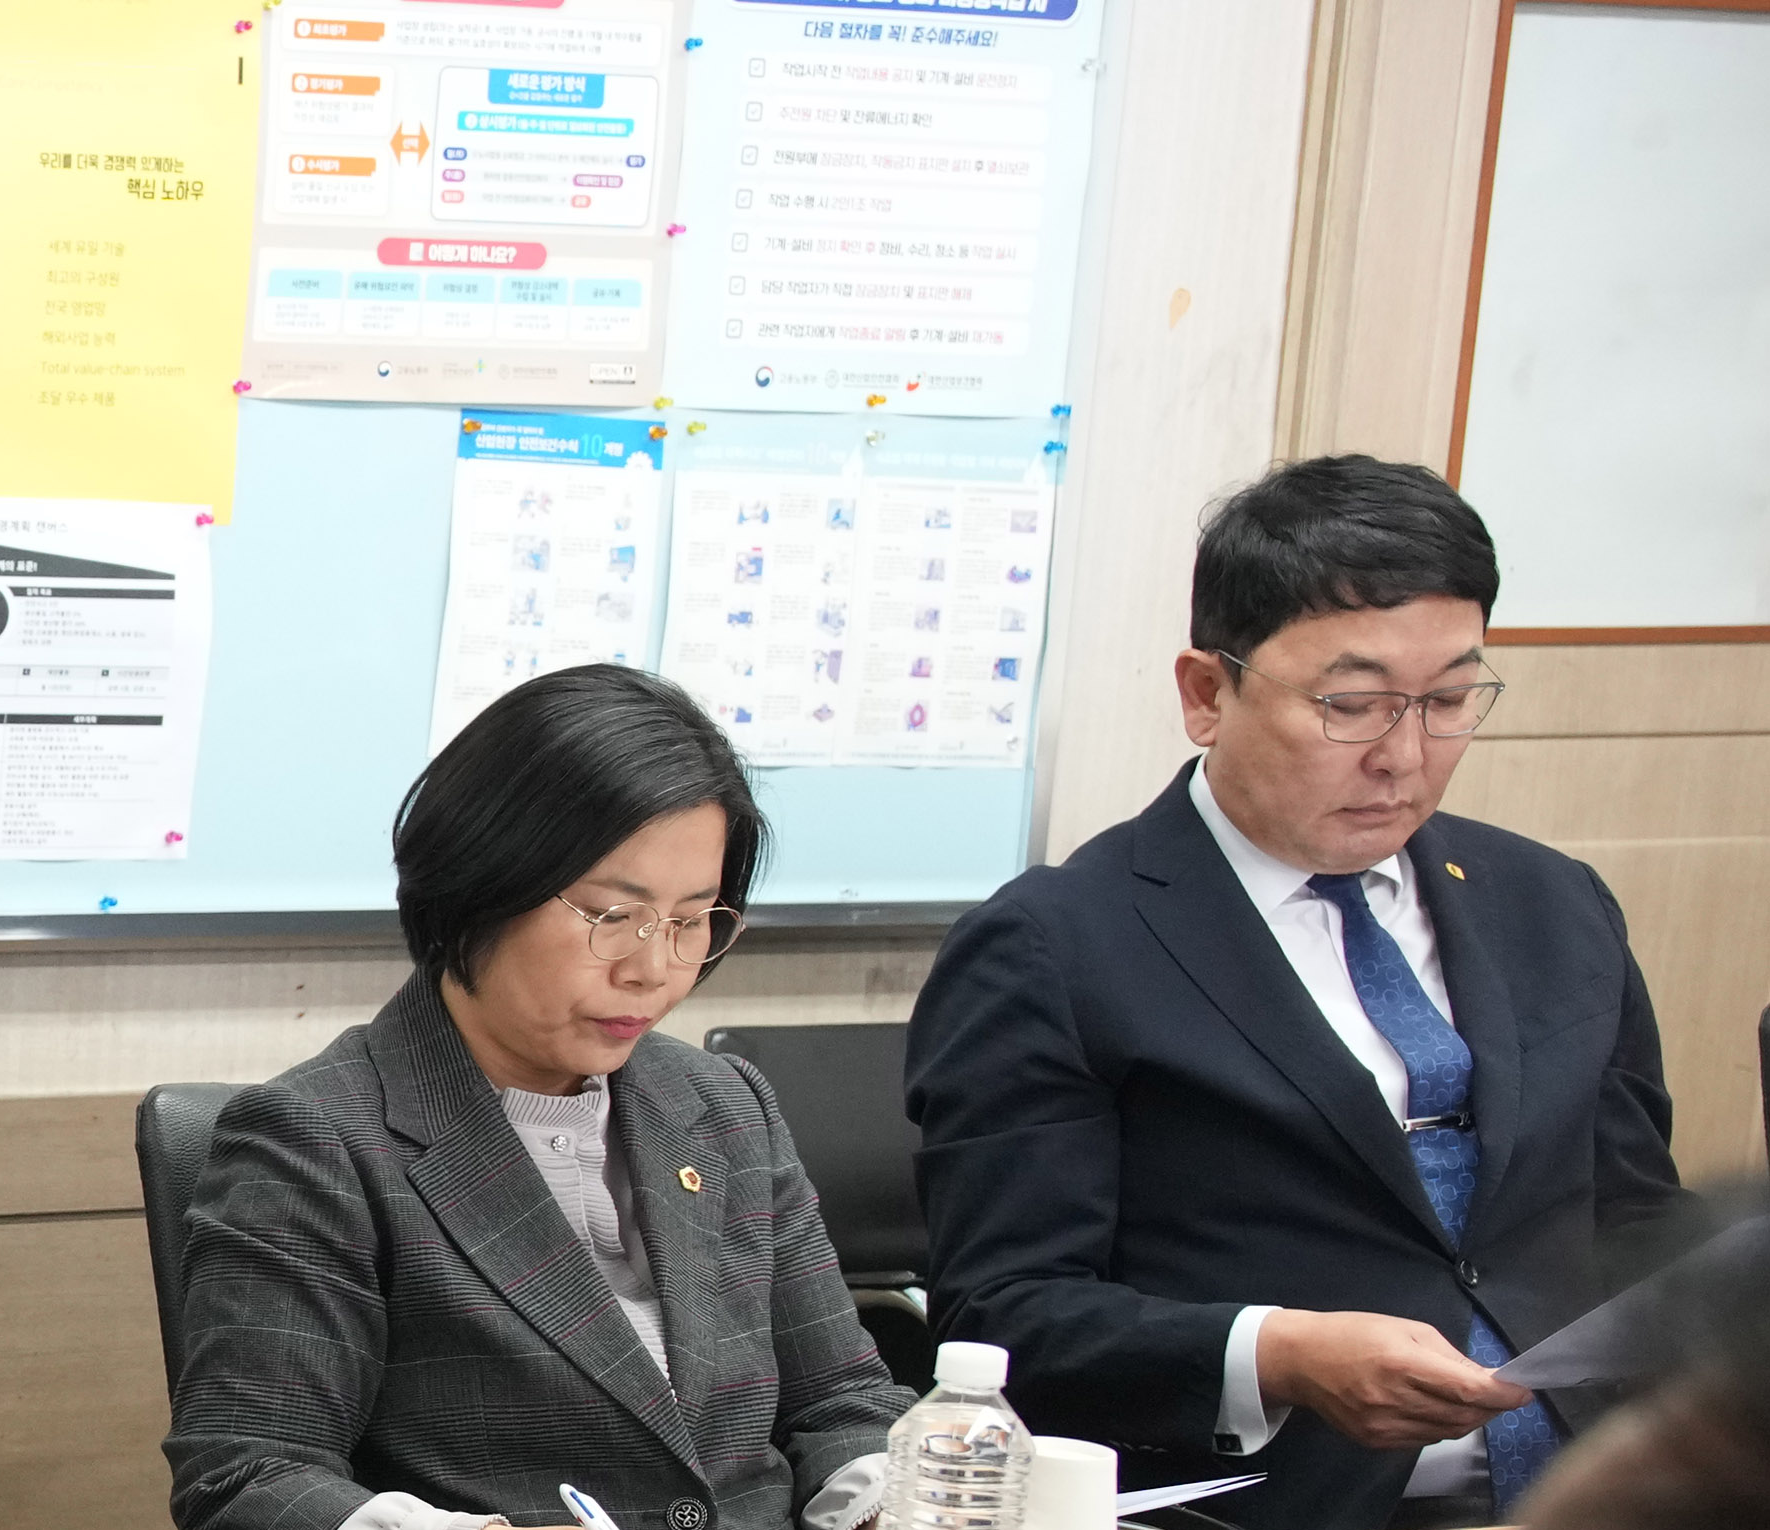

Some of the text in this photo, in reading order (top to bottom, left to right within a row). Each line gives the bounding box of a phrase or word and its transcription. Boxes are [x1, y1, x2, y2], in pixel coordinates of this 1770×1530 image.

[804, 21, 834, 39] 다음
[840, 22, 882, 41] 절차를
[40, 152, 71, 169] 우리를
[127, 178, 204, 201] 핵심 노하우
[40, 360, 70, 375] Total
[143, 363, 186, 378] system
